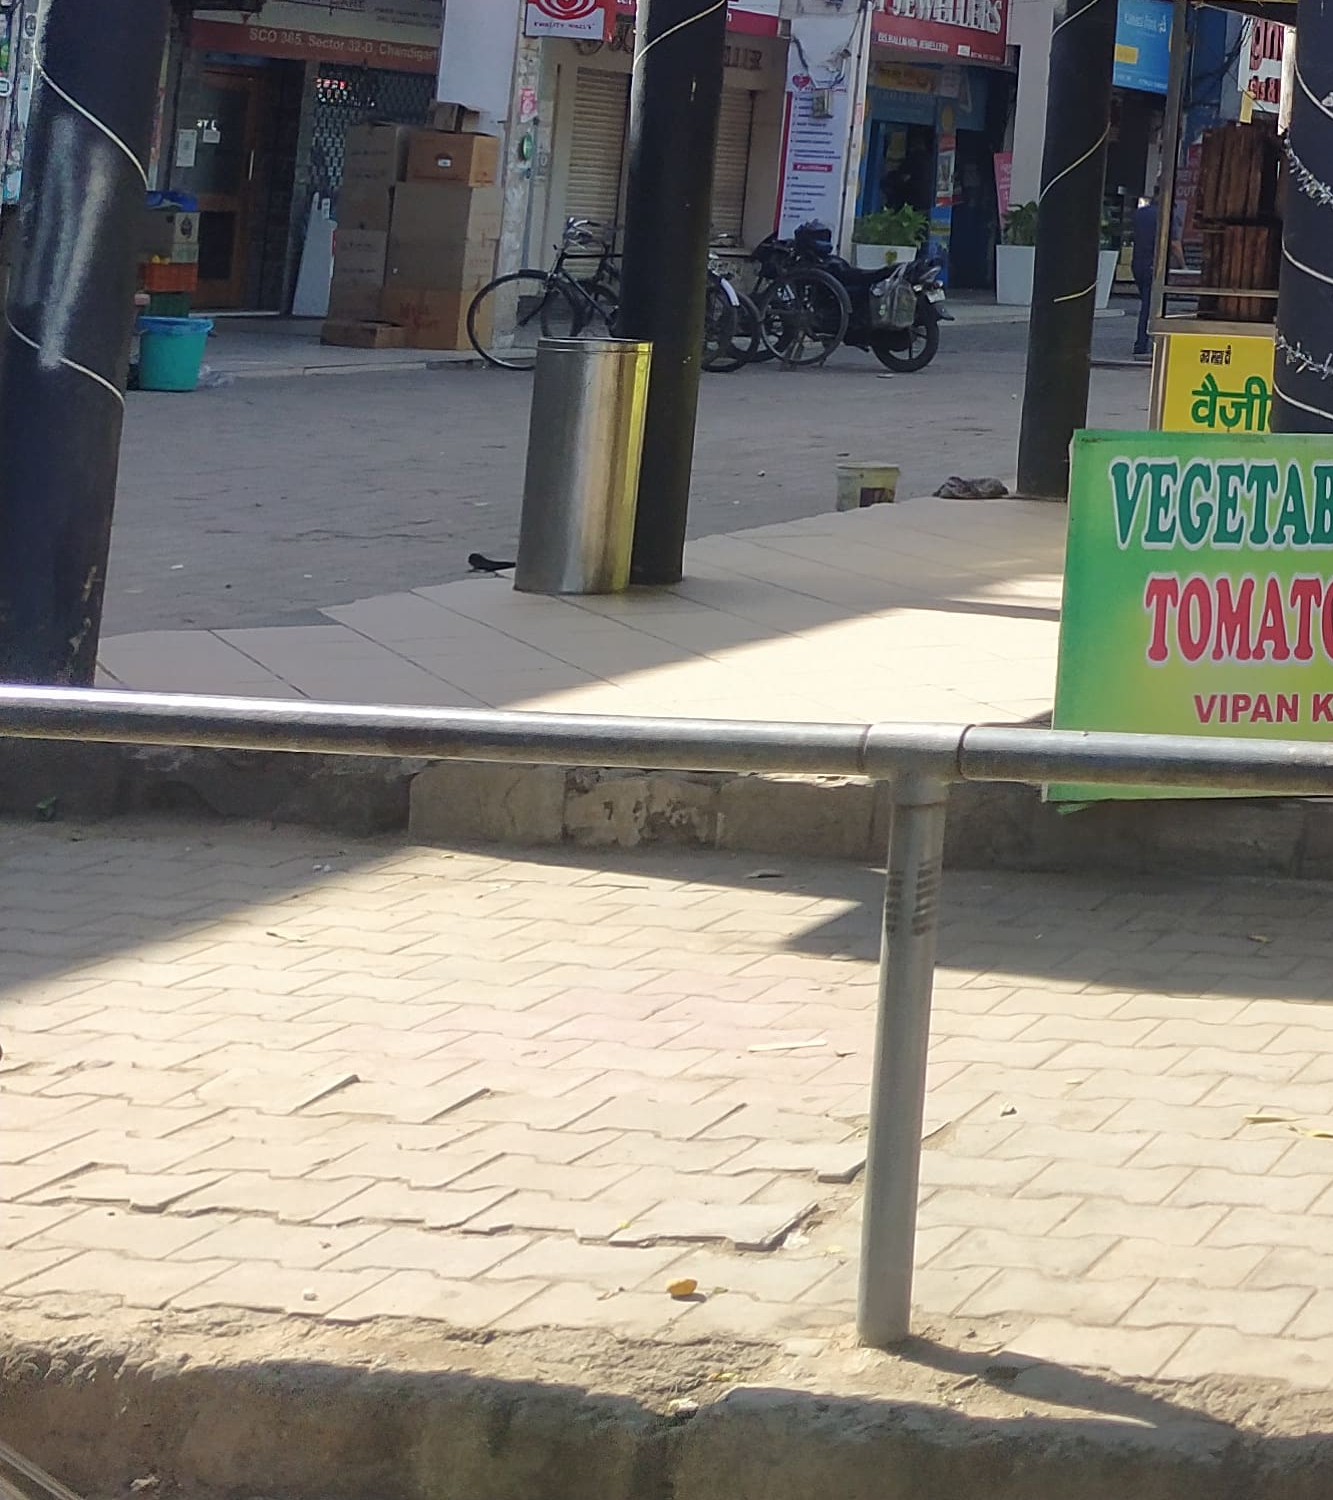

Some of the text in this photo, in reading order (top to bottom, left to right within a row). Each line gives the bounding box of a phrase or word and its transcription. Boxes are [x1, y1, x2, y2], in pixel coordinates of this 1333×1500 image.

[250, 28, 277, 43] SCO
[308, 35, 345, 51] Sector
[1194, 693, 1299, 724] VIPAN
